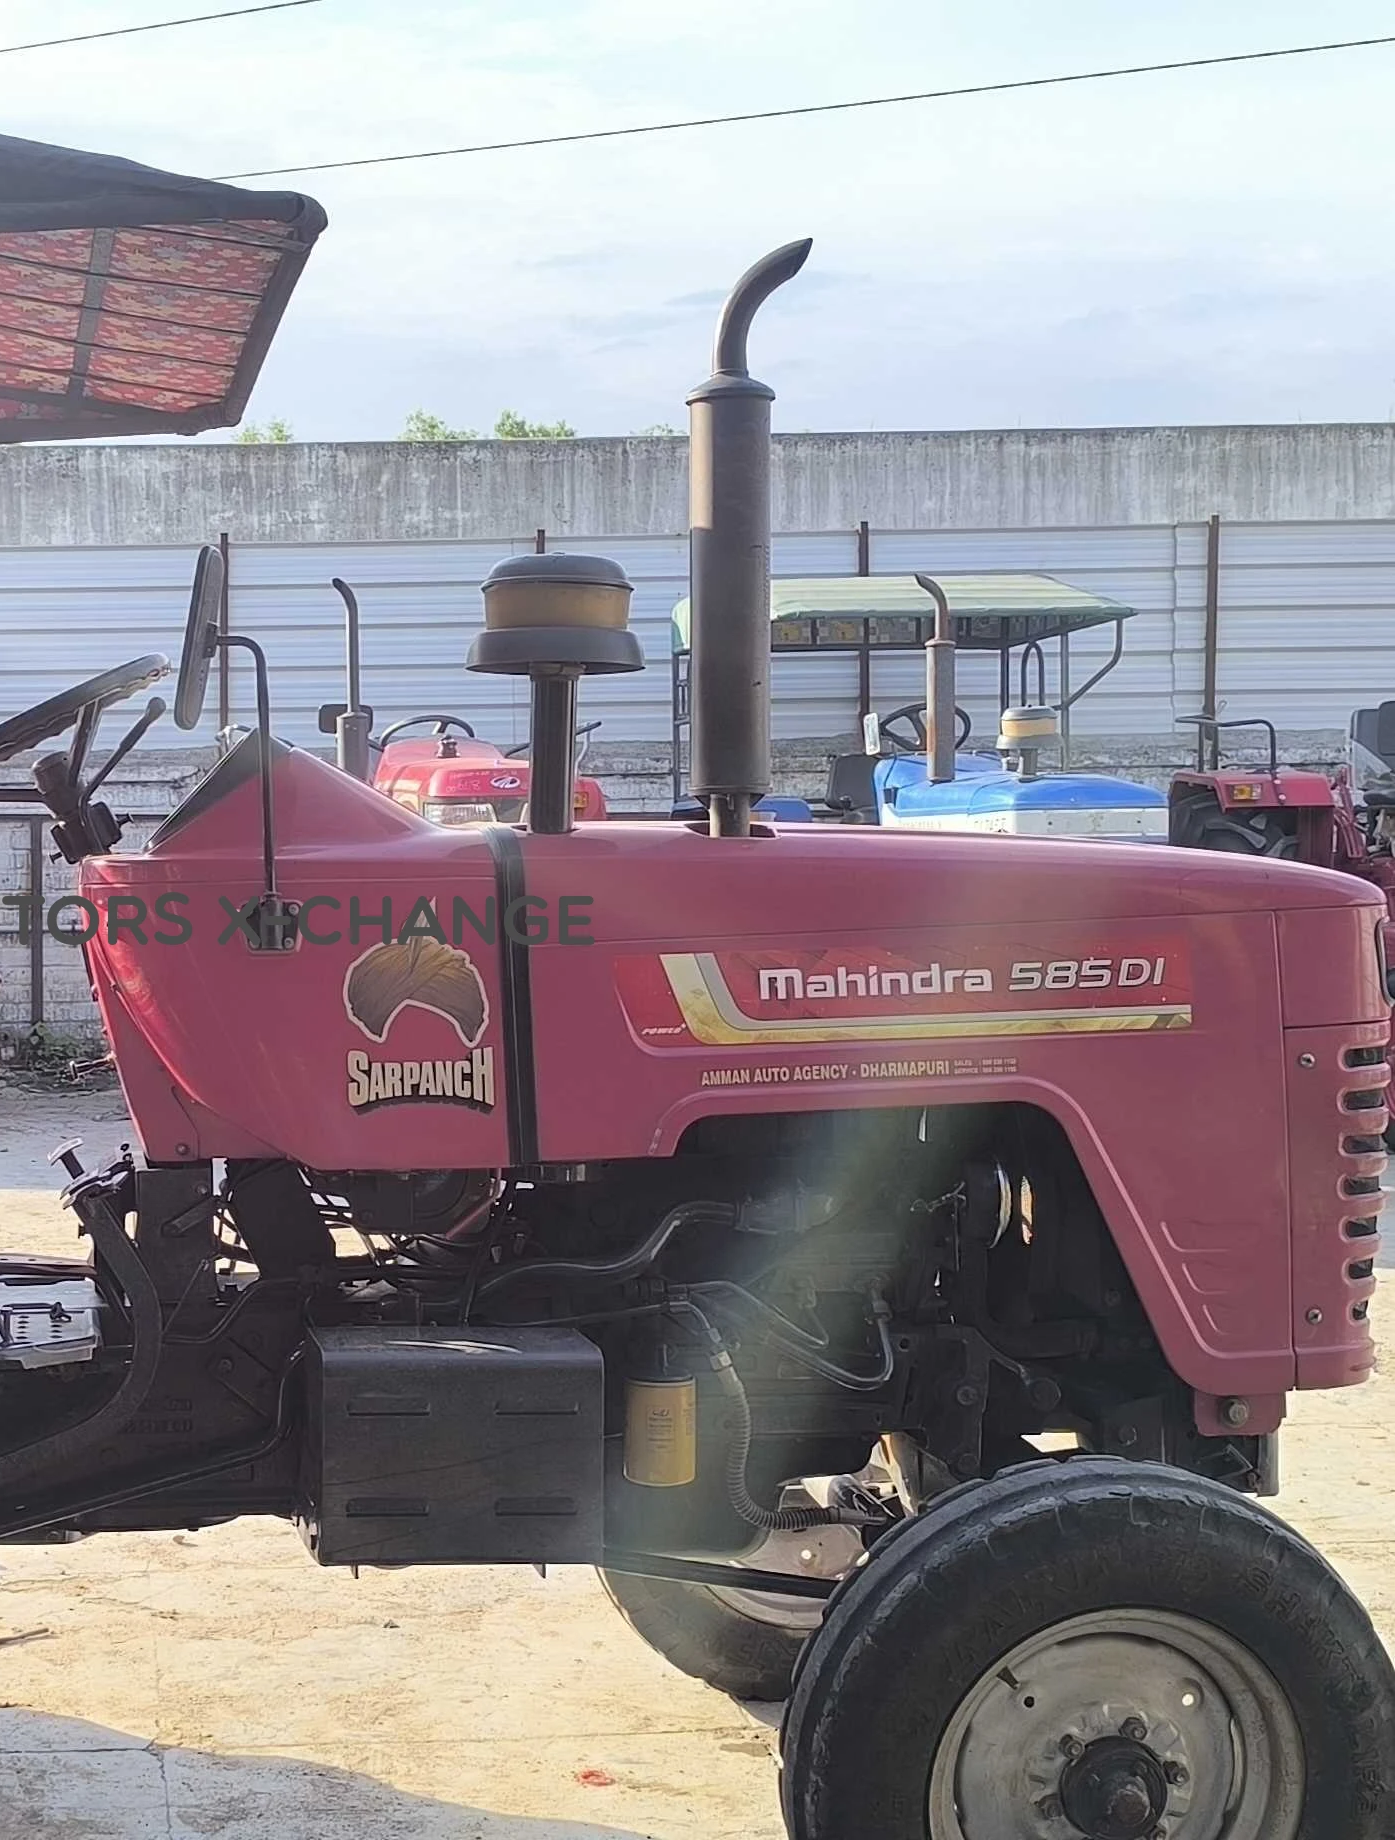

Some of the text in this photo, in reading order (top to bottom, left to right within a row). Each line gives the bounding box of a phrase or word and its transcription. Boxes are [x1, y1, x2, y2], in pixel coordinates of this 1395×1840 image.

[759, 963, 994, 1001] Mahindra
[346, 1046, 496, 1110] SARPANCH
[701, 1060, 951, 1087] AMMAN AUTO AGENCY DHARMAPURI
